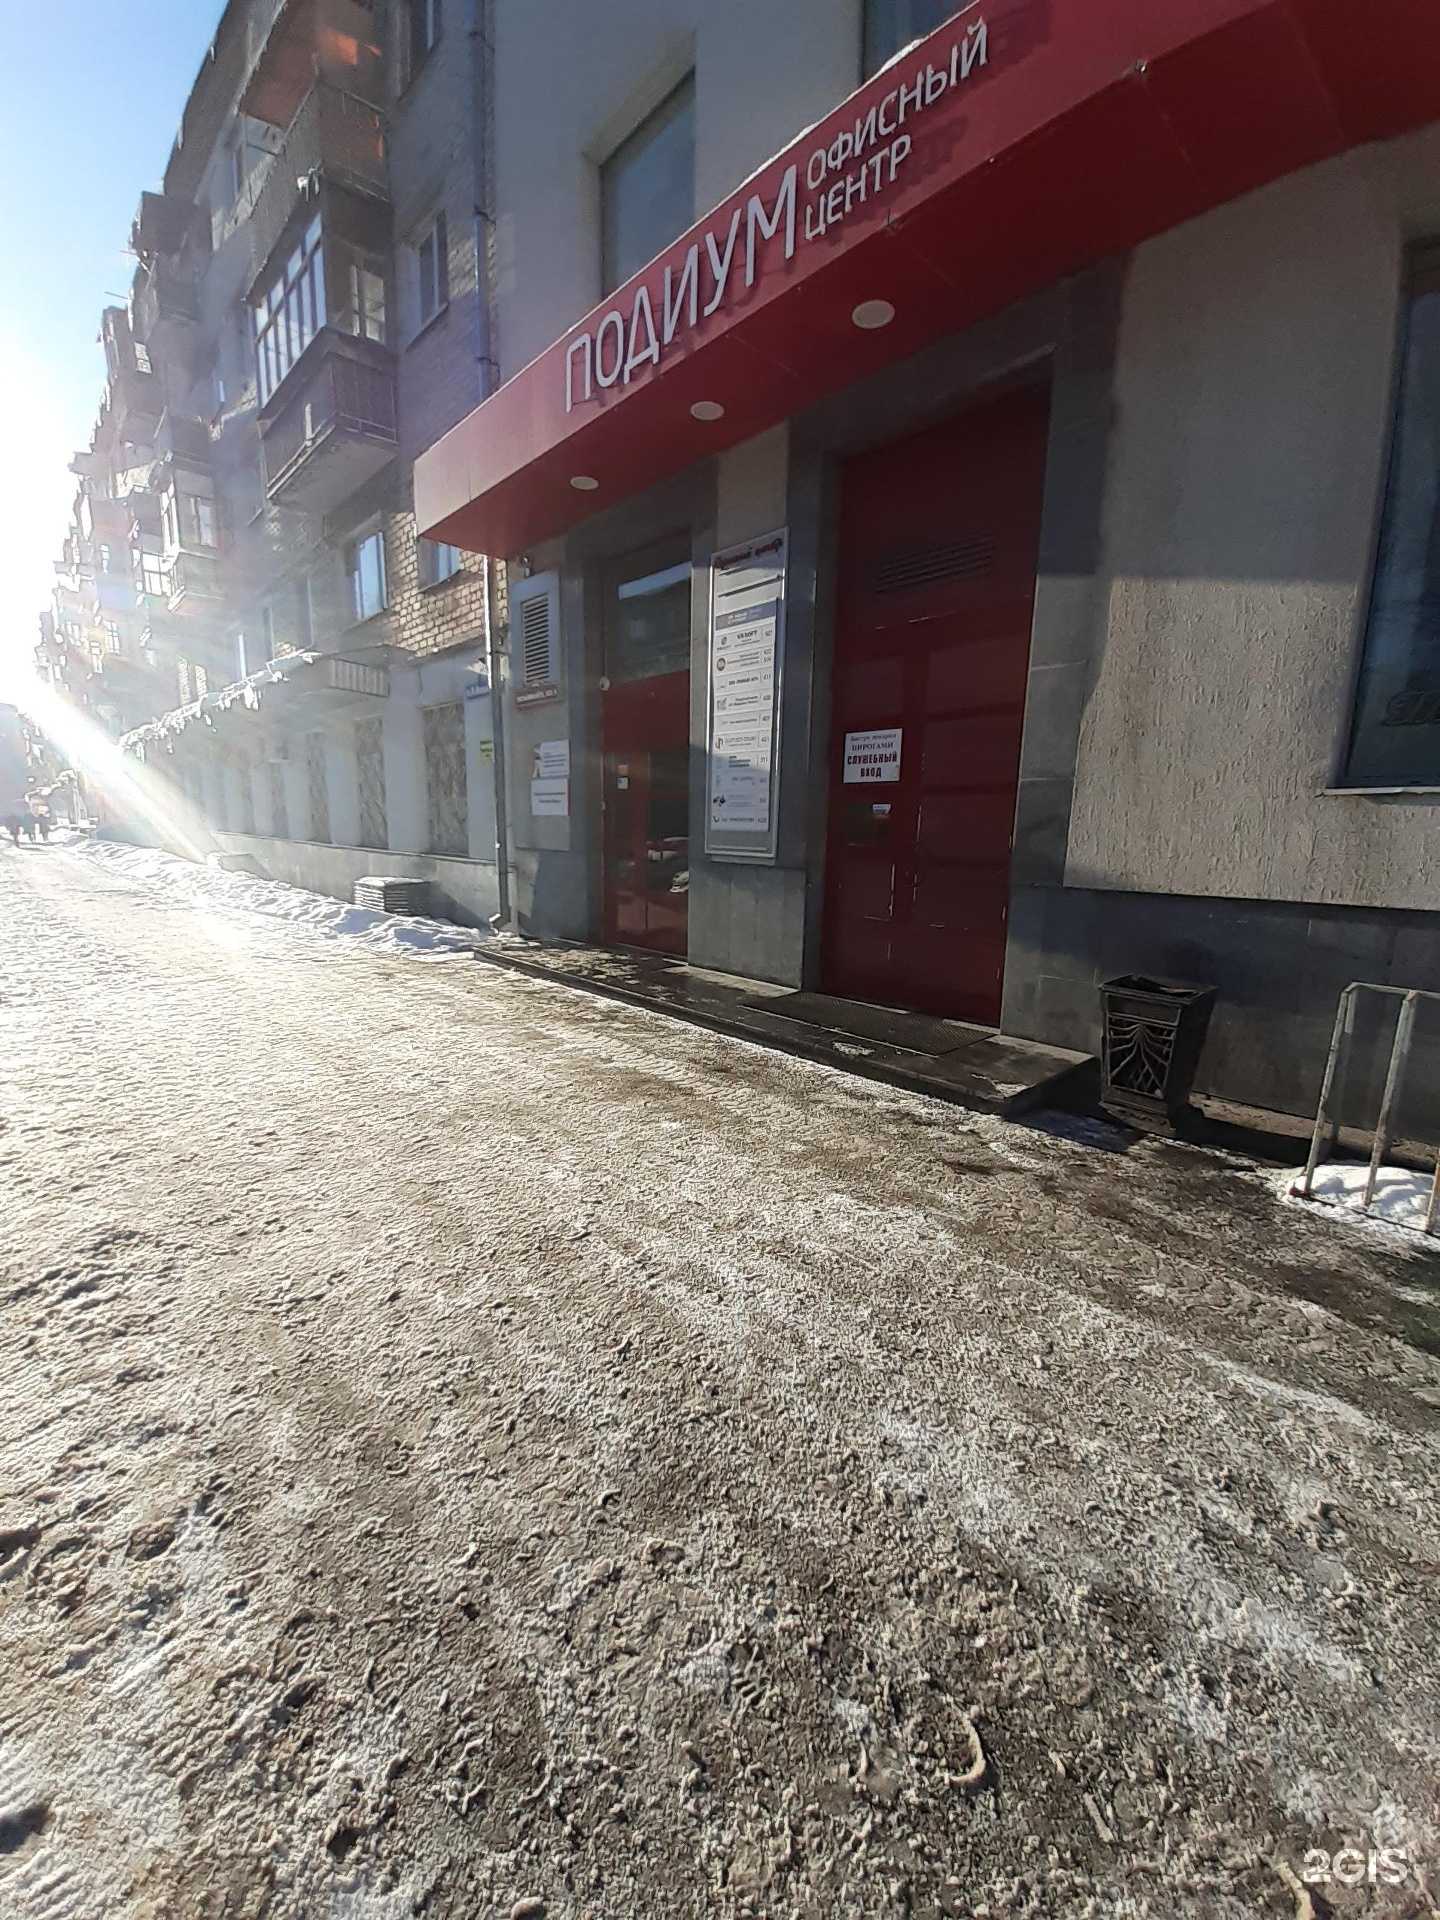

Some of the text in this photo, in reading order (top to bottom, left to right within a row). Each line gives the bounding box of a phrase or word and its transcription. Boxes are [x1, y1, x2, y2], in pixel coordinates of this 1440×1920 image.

[807, 16, 988, 190] ОФИСНЫЙ
[805, 135, 912, 241] ЦЕНТР
[565, 164, 798, 413] ПОДИУМ
[847, 751, 898, 765] СЛУЖЕБНЫЙ
[860, 767, 882, 778] ВХОД
